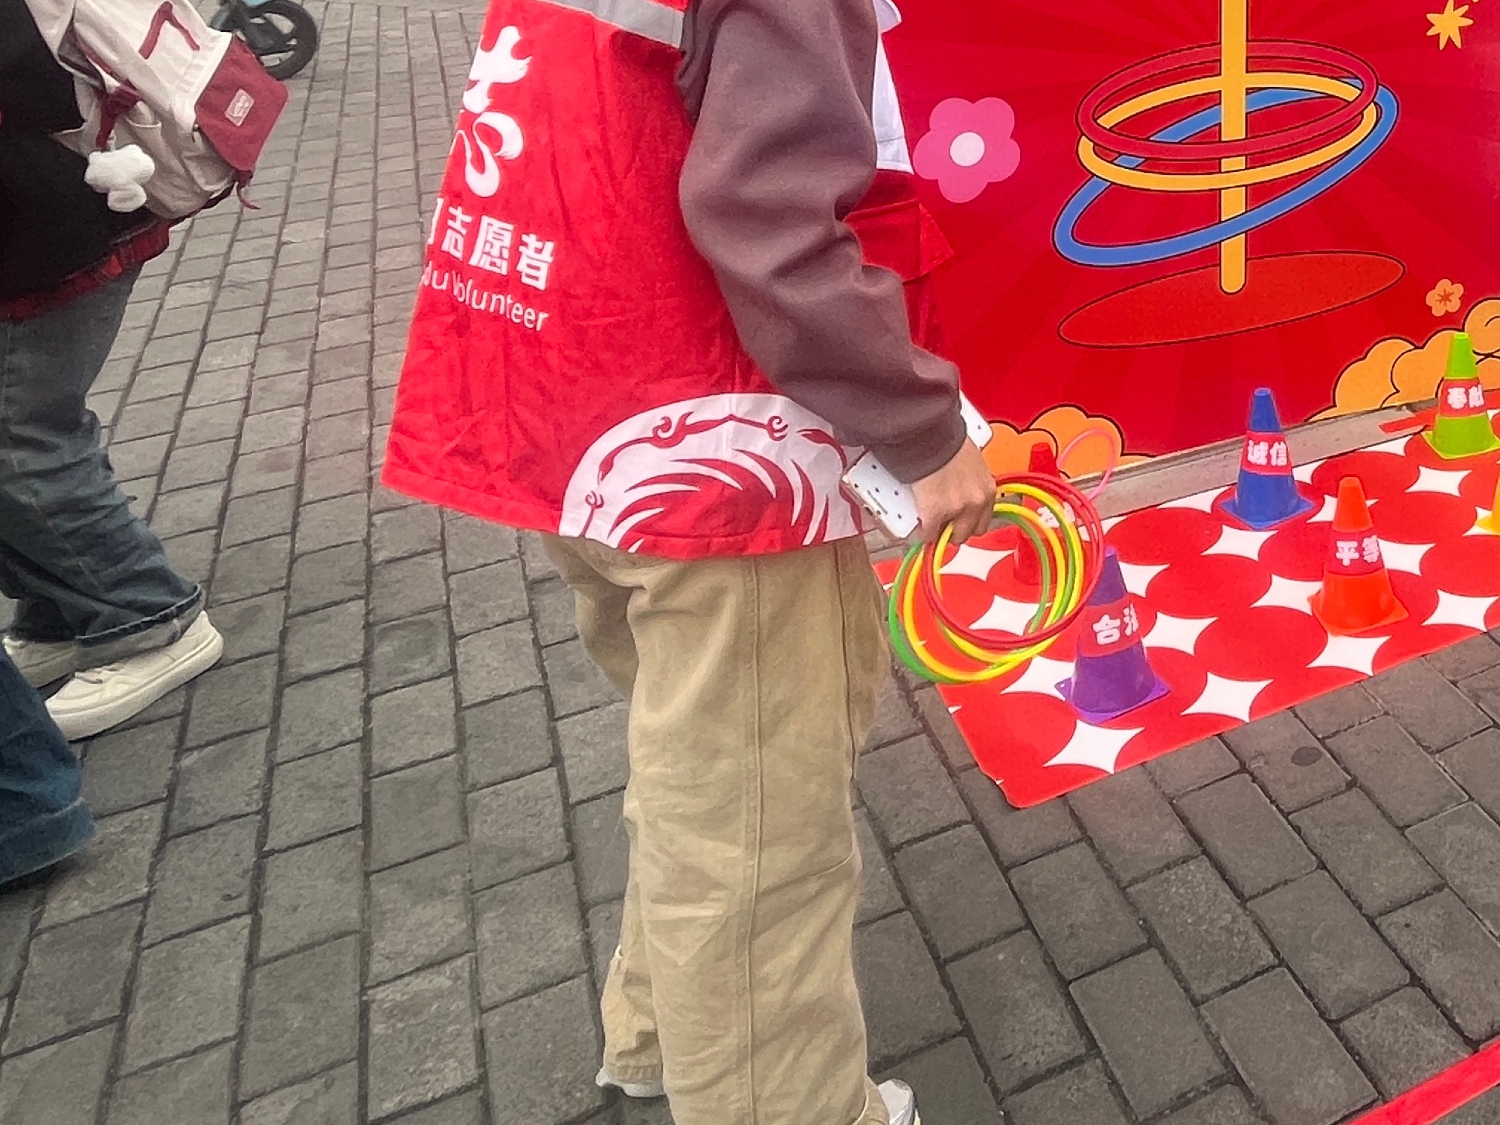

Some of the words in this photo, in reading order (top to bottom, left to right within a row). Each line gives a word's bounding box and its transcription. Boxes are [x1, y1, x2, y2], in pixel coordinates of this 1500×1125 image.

[427, 197, 555, 291] 志愿者
[451, 269, 549, 332] Volunteer
[1246, 439, 1288, 466] 诚信
[1335, 534, 1380, 566] 平等
